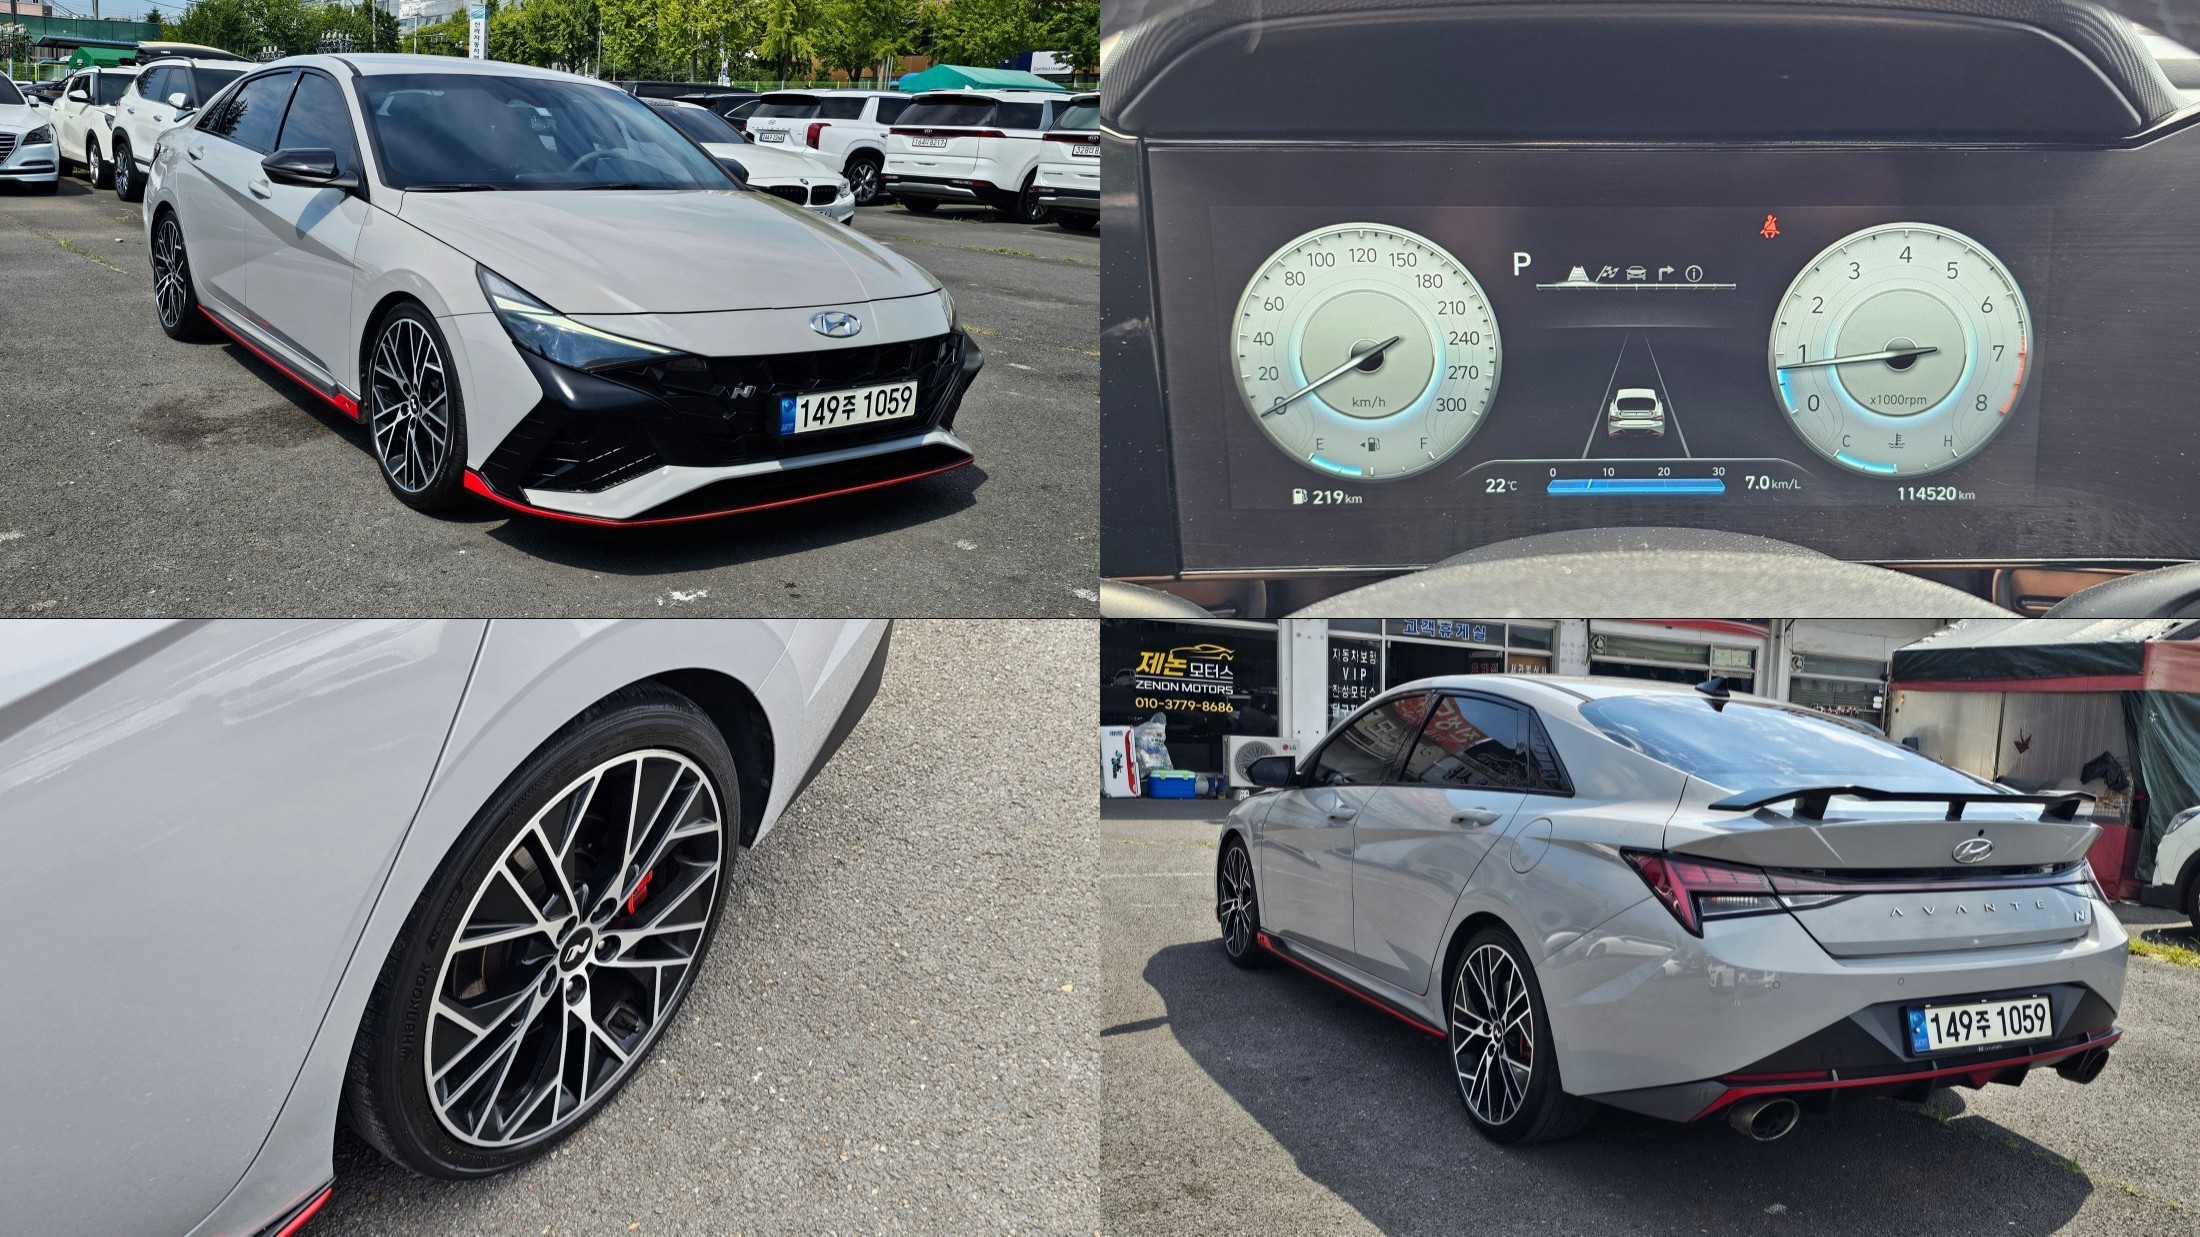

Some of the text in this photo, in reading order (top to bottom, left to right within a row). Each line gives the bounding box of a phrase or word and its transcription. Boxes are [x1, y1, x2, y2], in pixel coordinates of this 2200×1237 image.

[1307, 252, 1336, 268] 100
[1349, 248, 1377, 264] 120
[1389, 253, 1417, 268] 150
[1900, 246, 1912, 263] 4
[1514, 252, 1532, 276] P
[1848, 262, 1860, 280] 3
[1948, 262, 1958, 279] 5
[1284, 272, 1306, 286] 80
[1415, 274, 1443, 288] 180
[1264, 296, 1284, 312] 60
[1438, 300, 1466, 316] 210
[1812, 297, 1824, 314] 2
[1982, 296, 1993, 313] 6
[1254, 332, 1274, 346] 40
[1450, 331, 1480, 346] 240
[1798, 344, 1806, 363] 1
[1992, 345, 2004, 362] 7
[1259, 366, 1279, 381] 20
[1448, 366, 1478, 380] 270
[800, 386, 913, 428] 149주 1059
[1274, 397, 1286, 414] 0
[1352, 396, 1386, 408] km/h
[1436, 398, 1466, 412] 300
[1808, 394, 1819, 411] 0
[1976, 394, 1987, 411] 8
[1316, 438, 1324, 450] E
[1420, 438, 1428, 450] F
[1842, 436, 1850, 447] C
[1944, 436, 1952, 447] H
[1550, 466, 1726, 477] 0 10 20 30
[1402, 619, 1487, 642] 고객휴게실
[1332, 648, 1376, 664] 자동차보험
[1136, 651, 1234, 678] 제논 모터스
[1136, 680, 1234, 695] ZENON MOTORS
[1135, 697, 1234, 713] 010-3779-8686
[1890, 900, 2046, 918] AVANTE
[1930, 1002, 2046, 1044] 149주 1059
